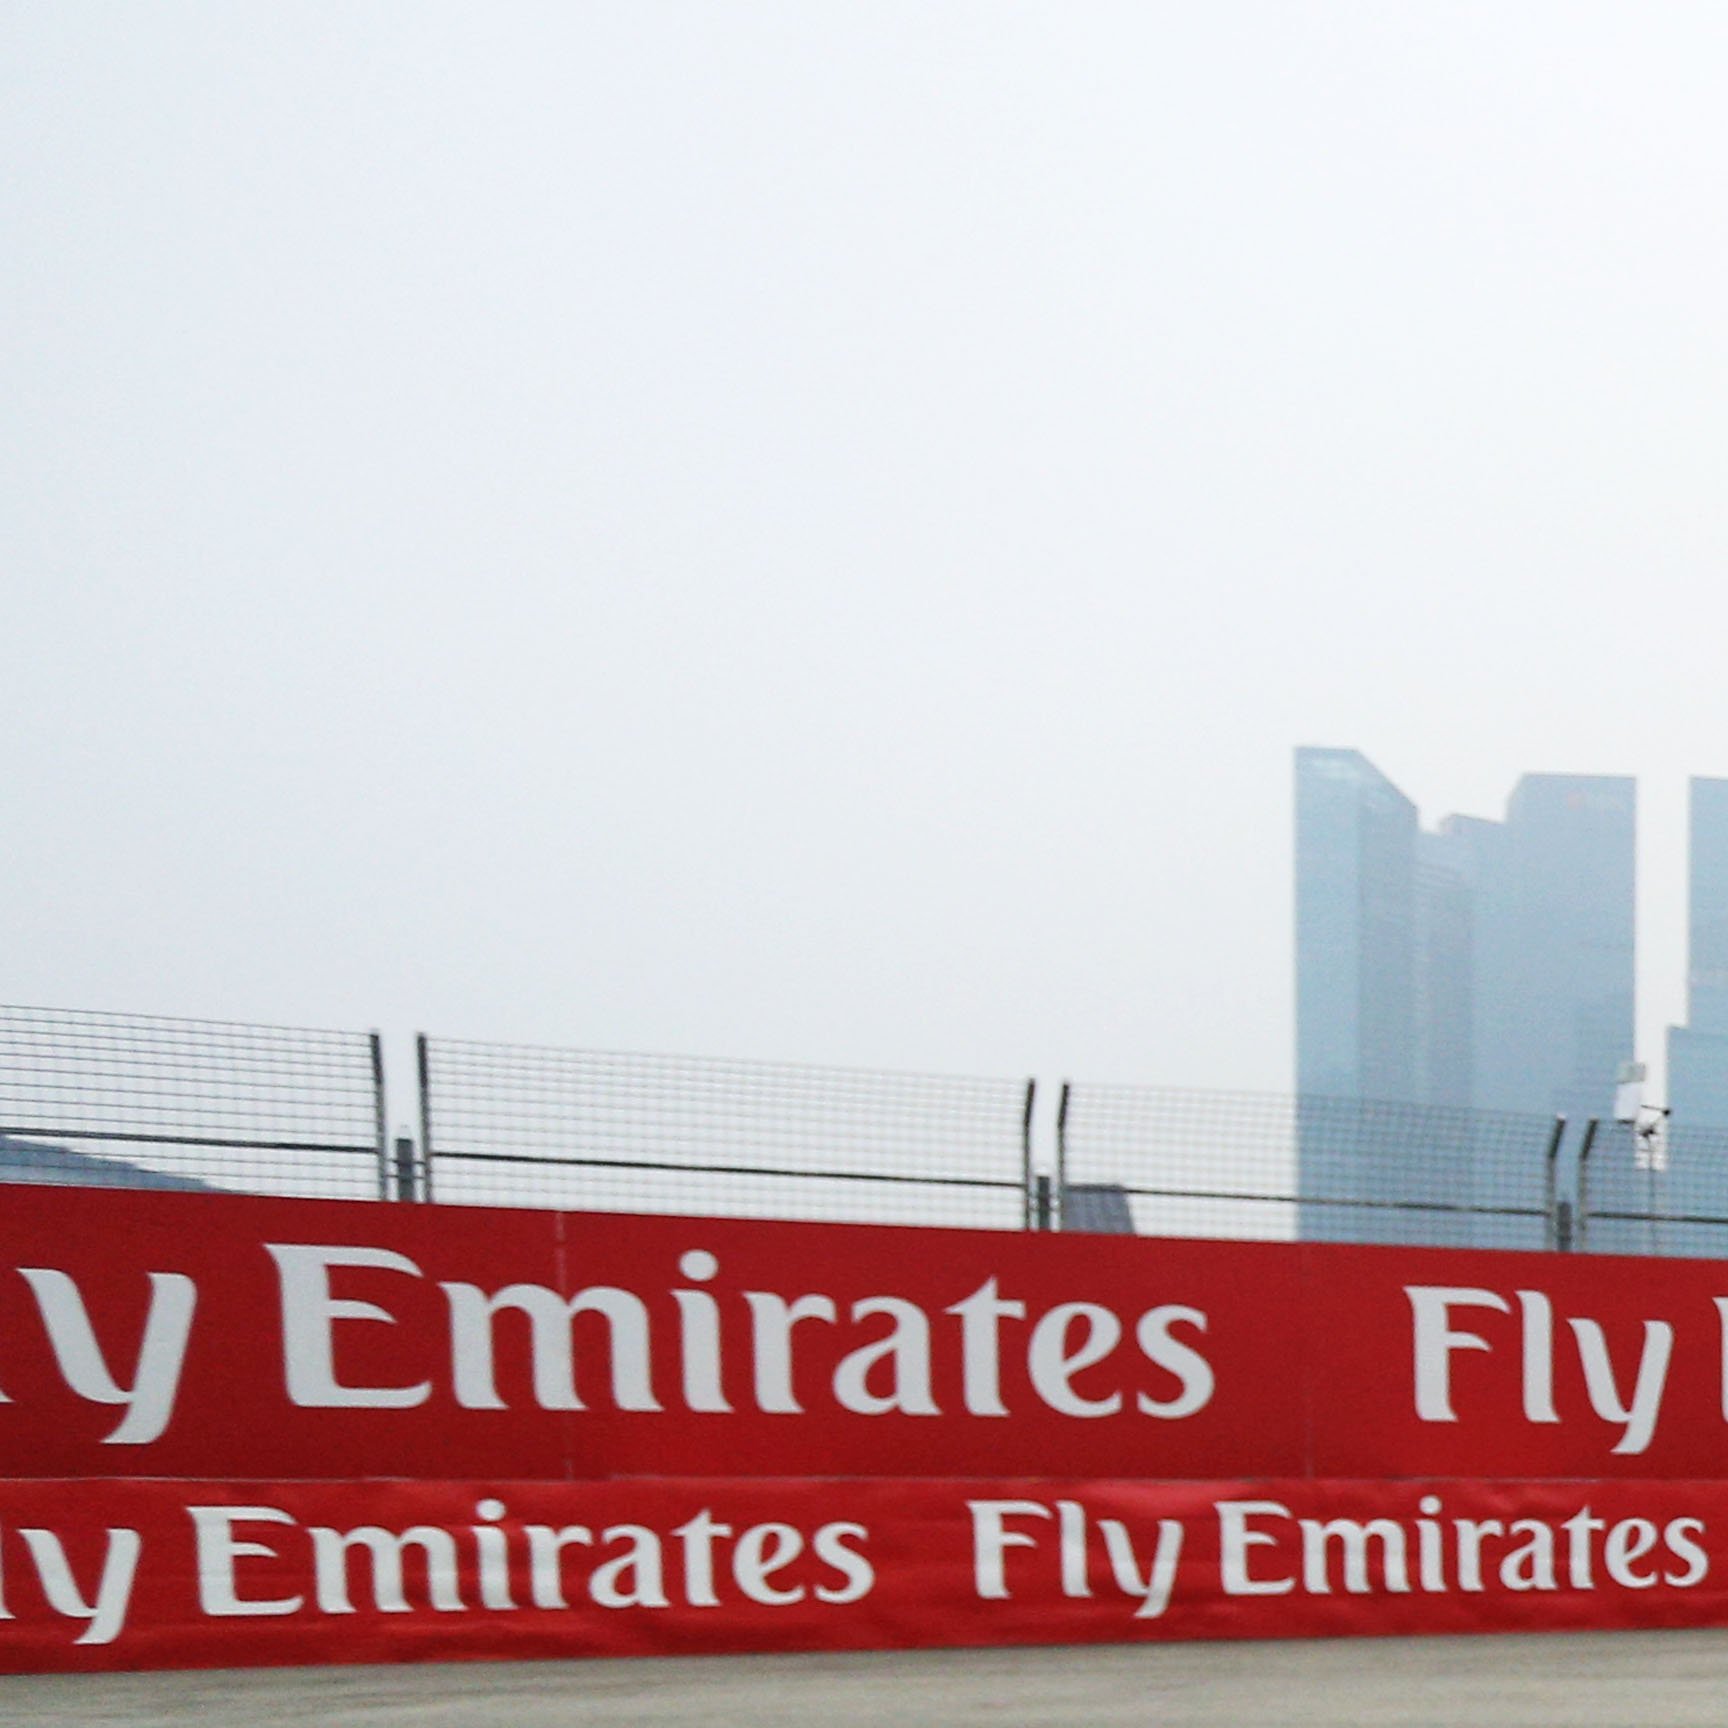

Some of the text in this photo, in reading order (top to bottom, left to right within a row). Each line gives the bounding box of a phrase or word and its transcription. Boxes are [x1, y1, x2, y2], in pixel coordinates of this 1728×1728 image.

[264, 1243, 1216, 1419] Emirates
[1404, 1286, 1673, 1454] Fly
[186, 1499, 874, 1615] Emirates
[968, 1501, 1183, 1618] Fly
[1215, 1496, 1708, 1594] Emirates
